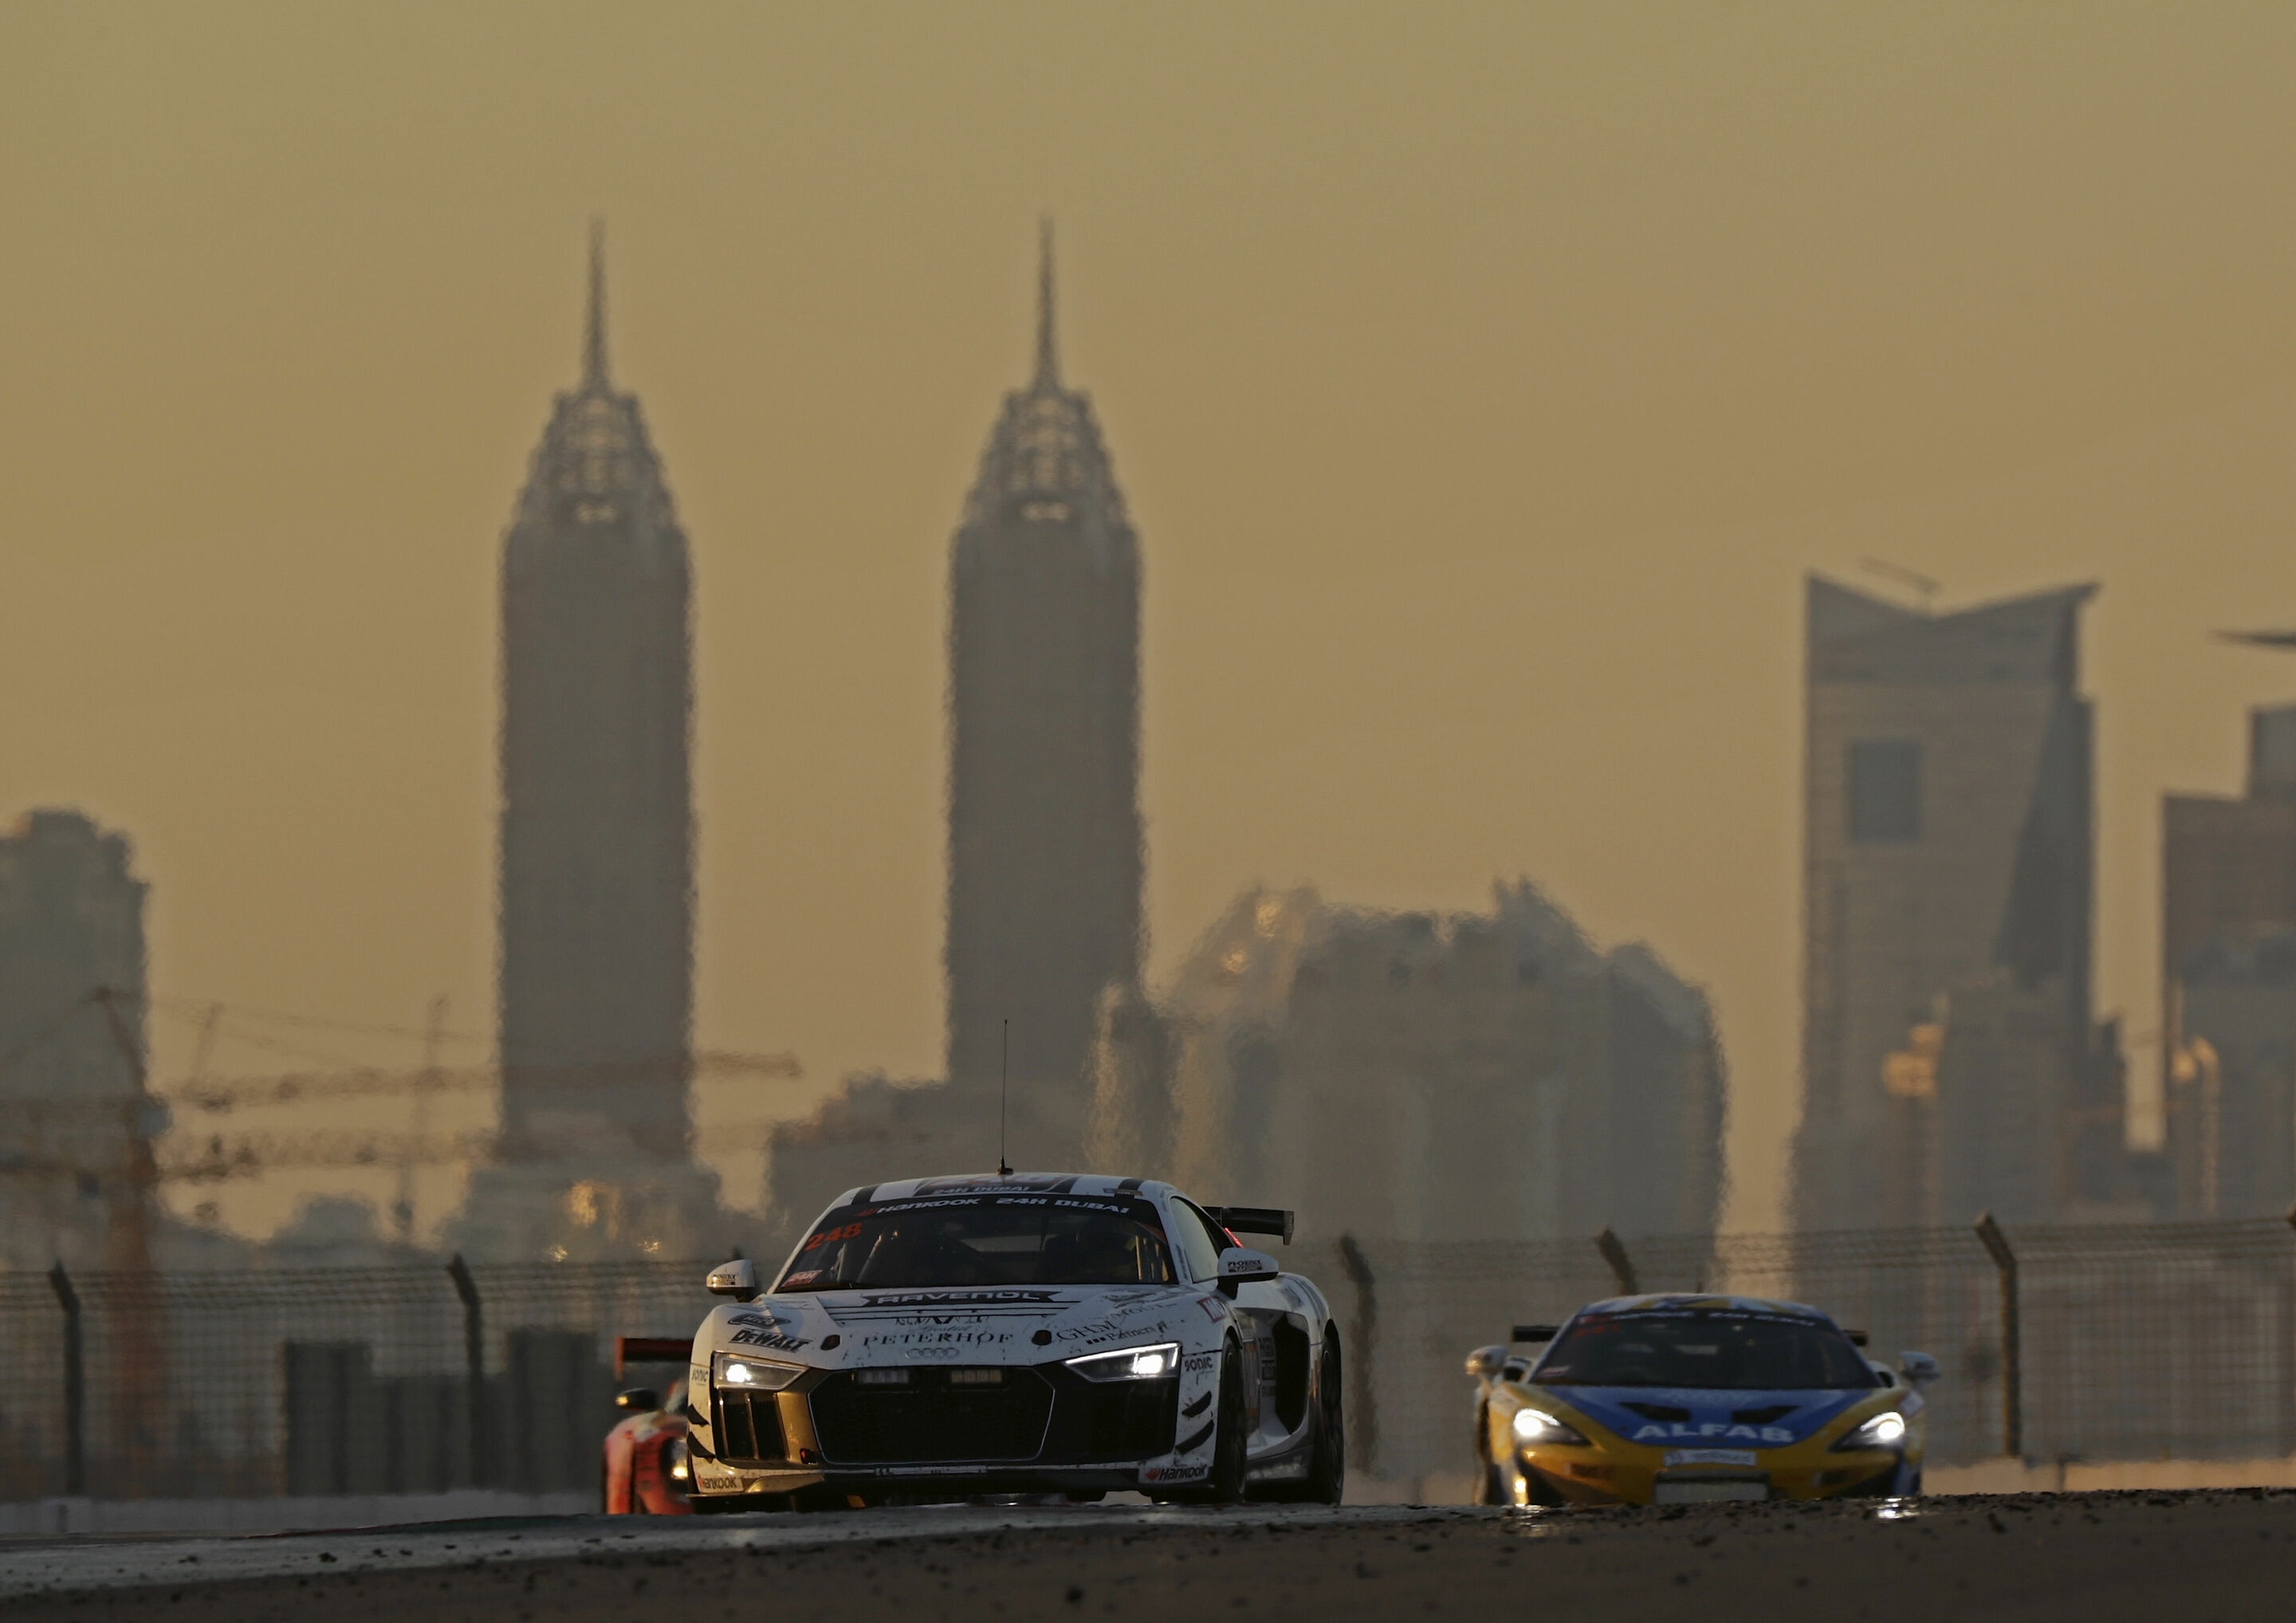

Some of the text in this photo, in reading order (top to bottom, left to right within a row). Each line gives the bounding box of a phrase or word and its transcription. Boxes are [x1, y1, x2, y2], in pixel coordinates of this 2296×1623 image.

[1055, 1199, 1130, 1213] DUBAI
[804, 1223, 863, 1252] 248
[1056, 1320, 1117, 1340] GHM
[1106, 1326, 1156, 1341] Partners
[863, 1332, 1014, 1347] PETERHOF
